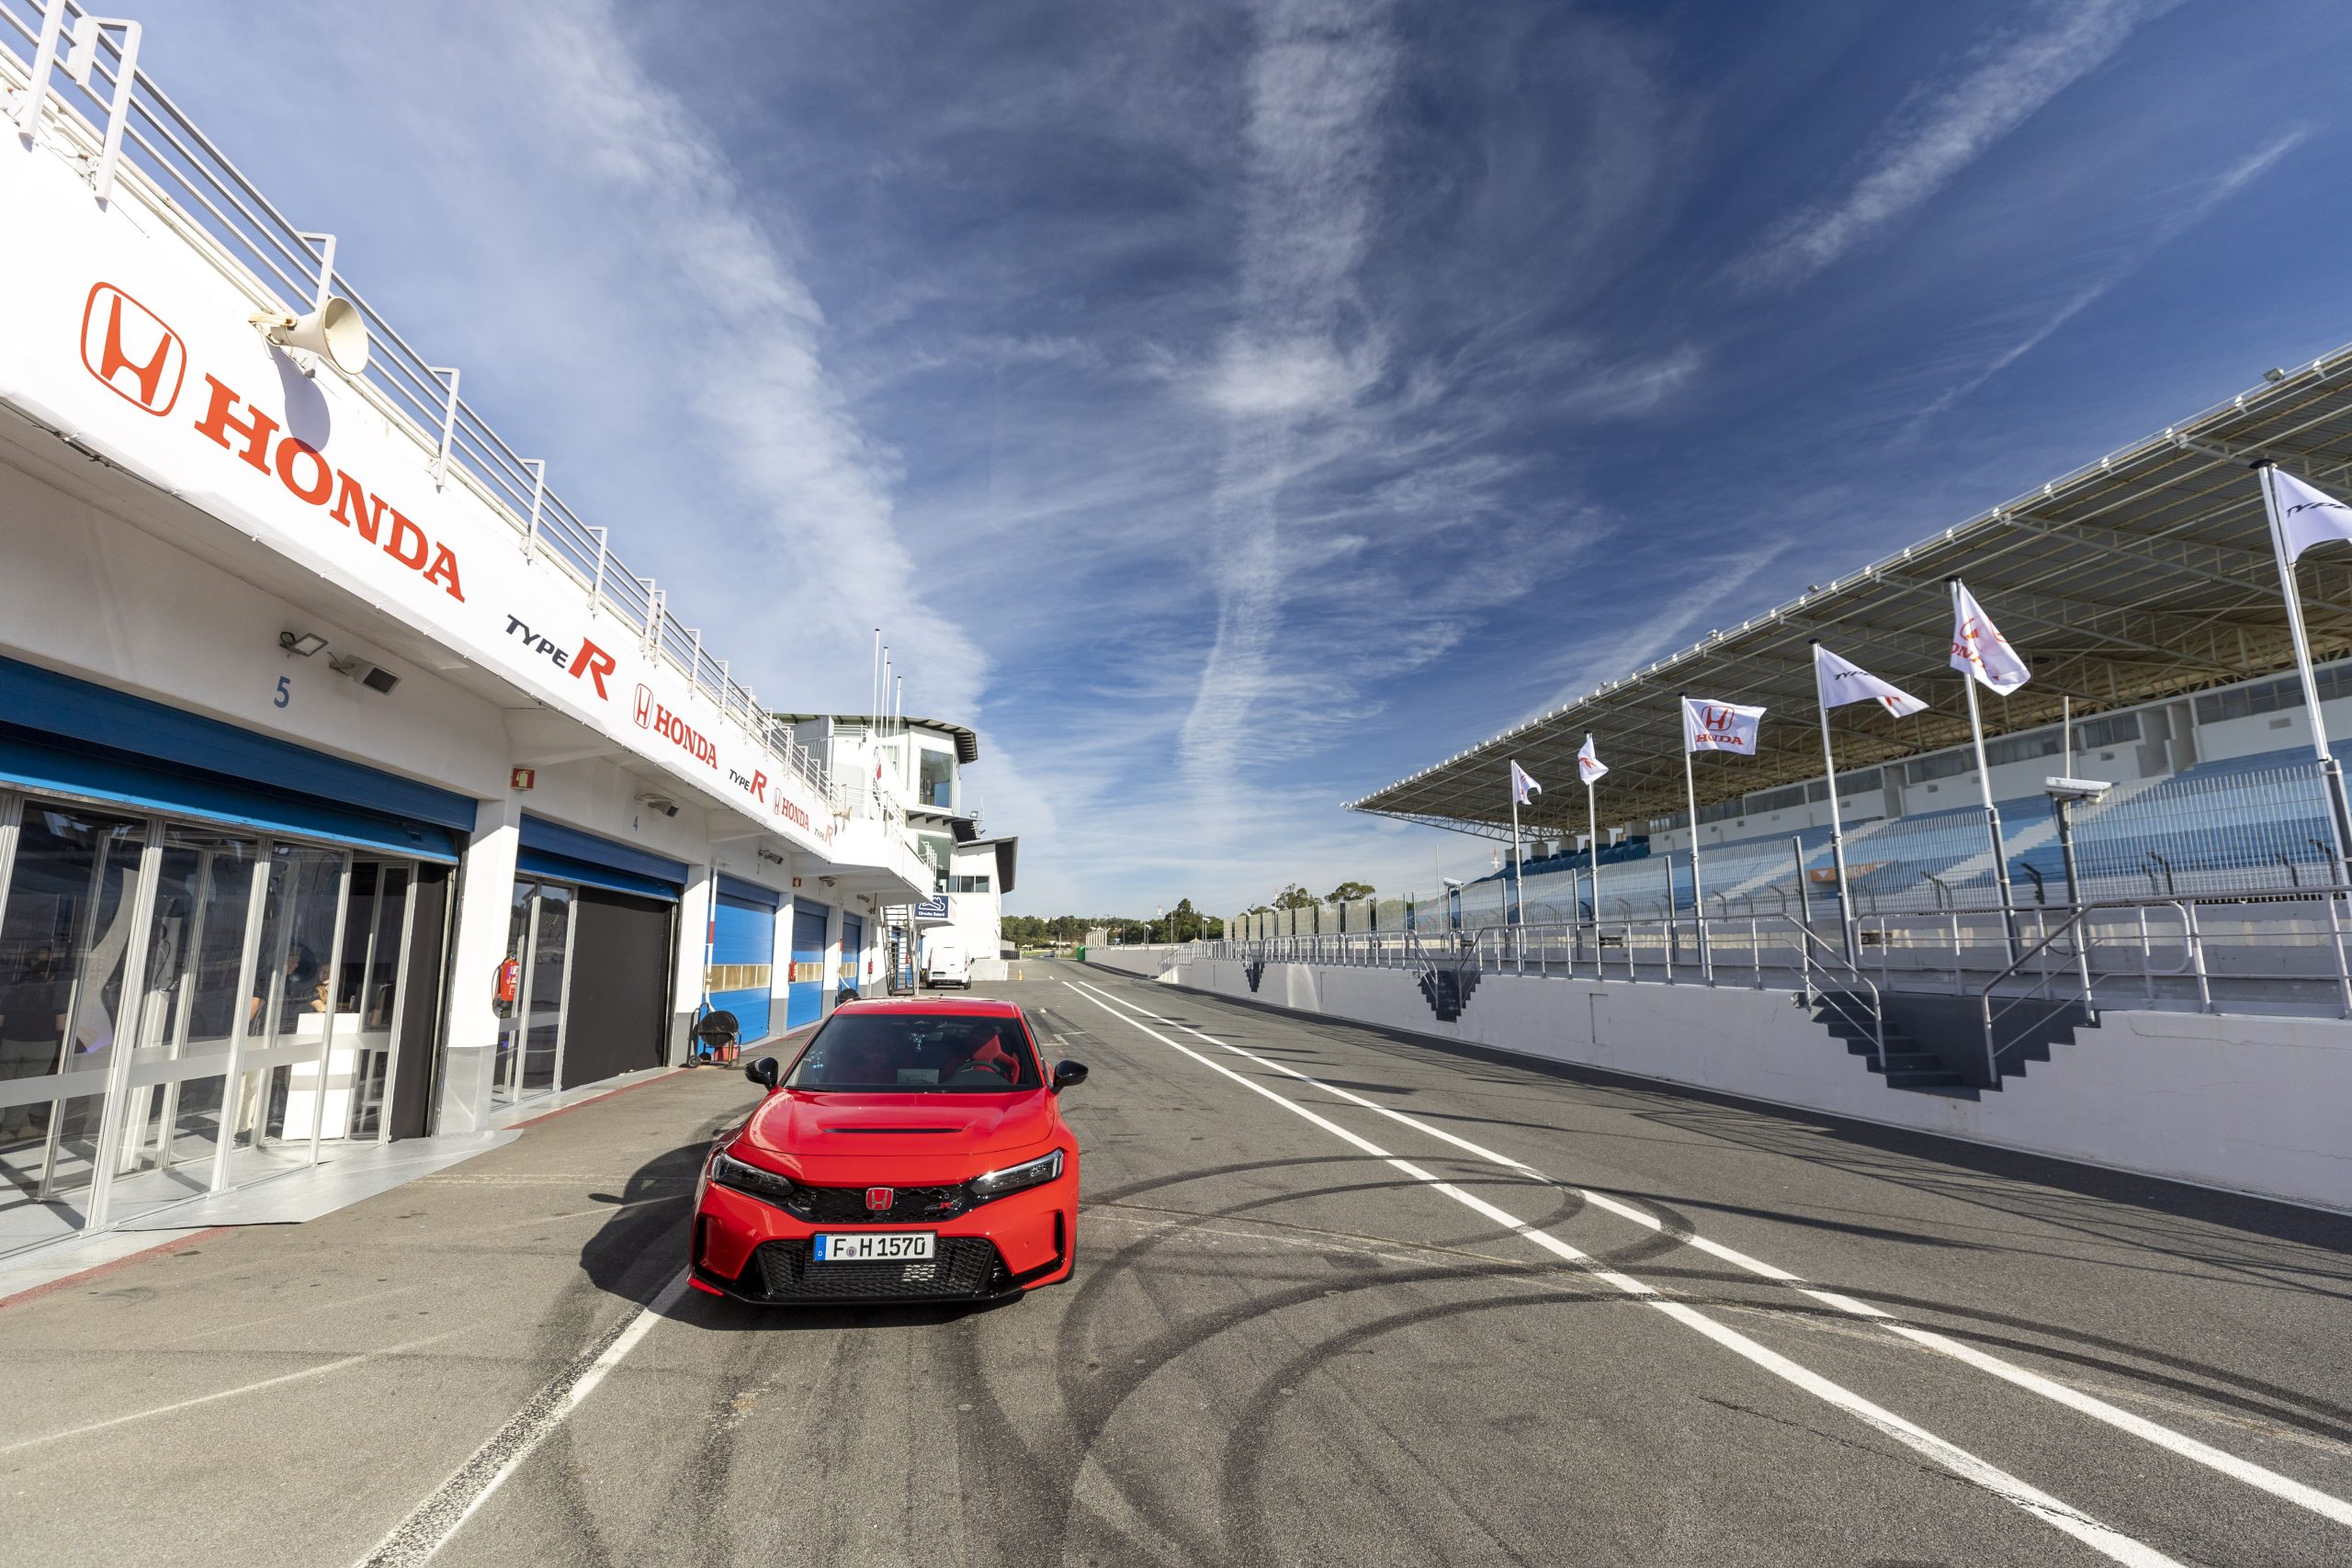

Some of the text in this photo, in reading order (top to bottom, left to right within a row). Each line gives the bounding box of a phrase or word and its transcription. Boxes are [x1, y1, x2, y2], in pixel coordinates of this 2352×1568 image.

[194, 372, 466, 604] HONDA
[505, 614, 616, 702] TYPE R
[274, 676, 291, 708] 5
[653, 703, 718, 771] HONDA
[729, 769, 768, 804] TYPE R
[781, 796, 809, 831] HONDA
[833, 1238, 846, 1258] F
